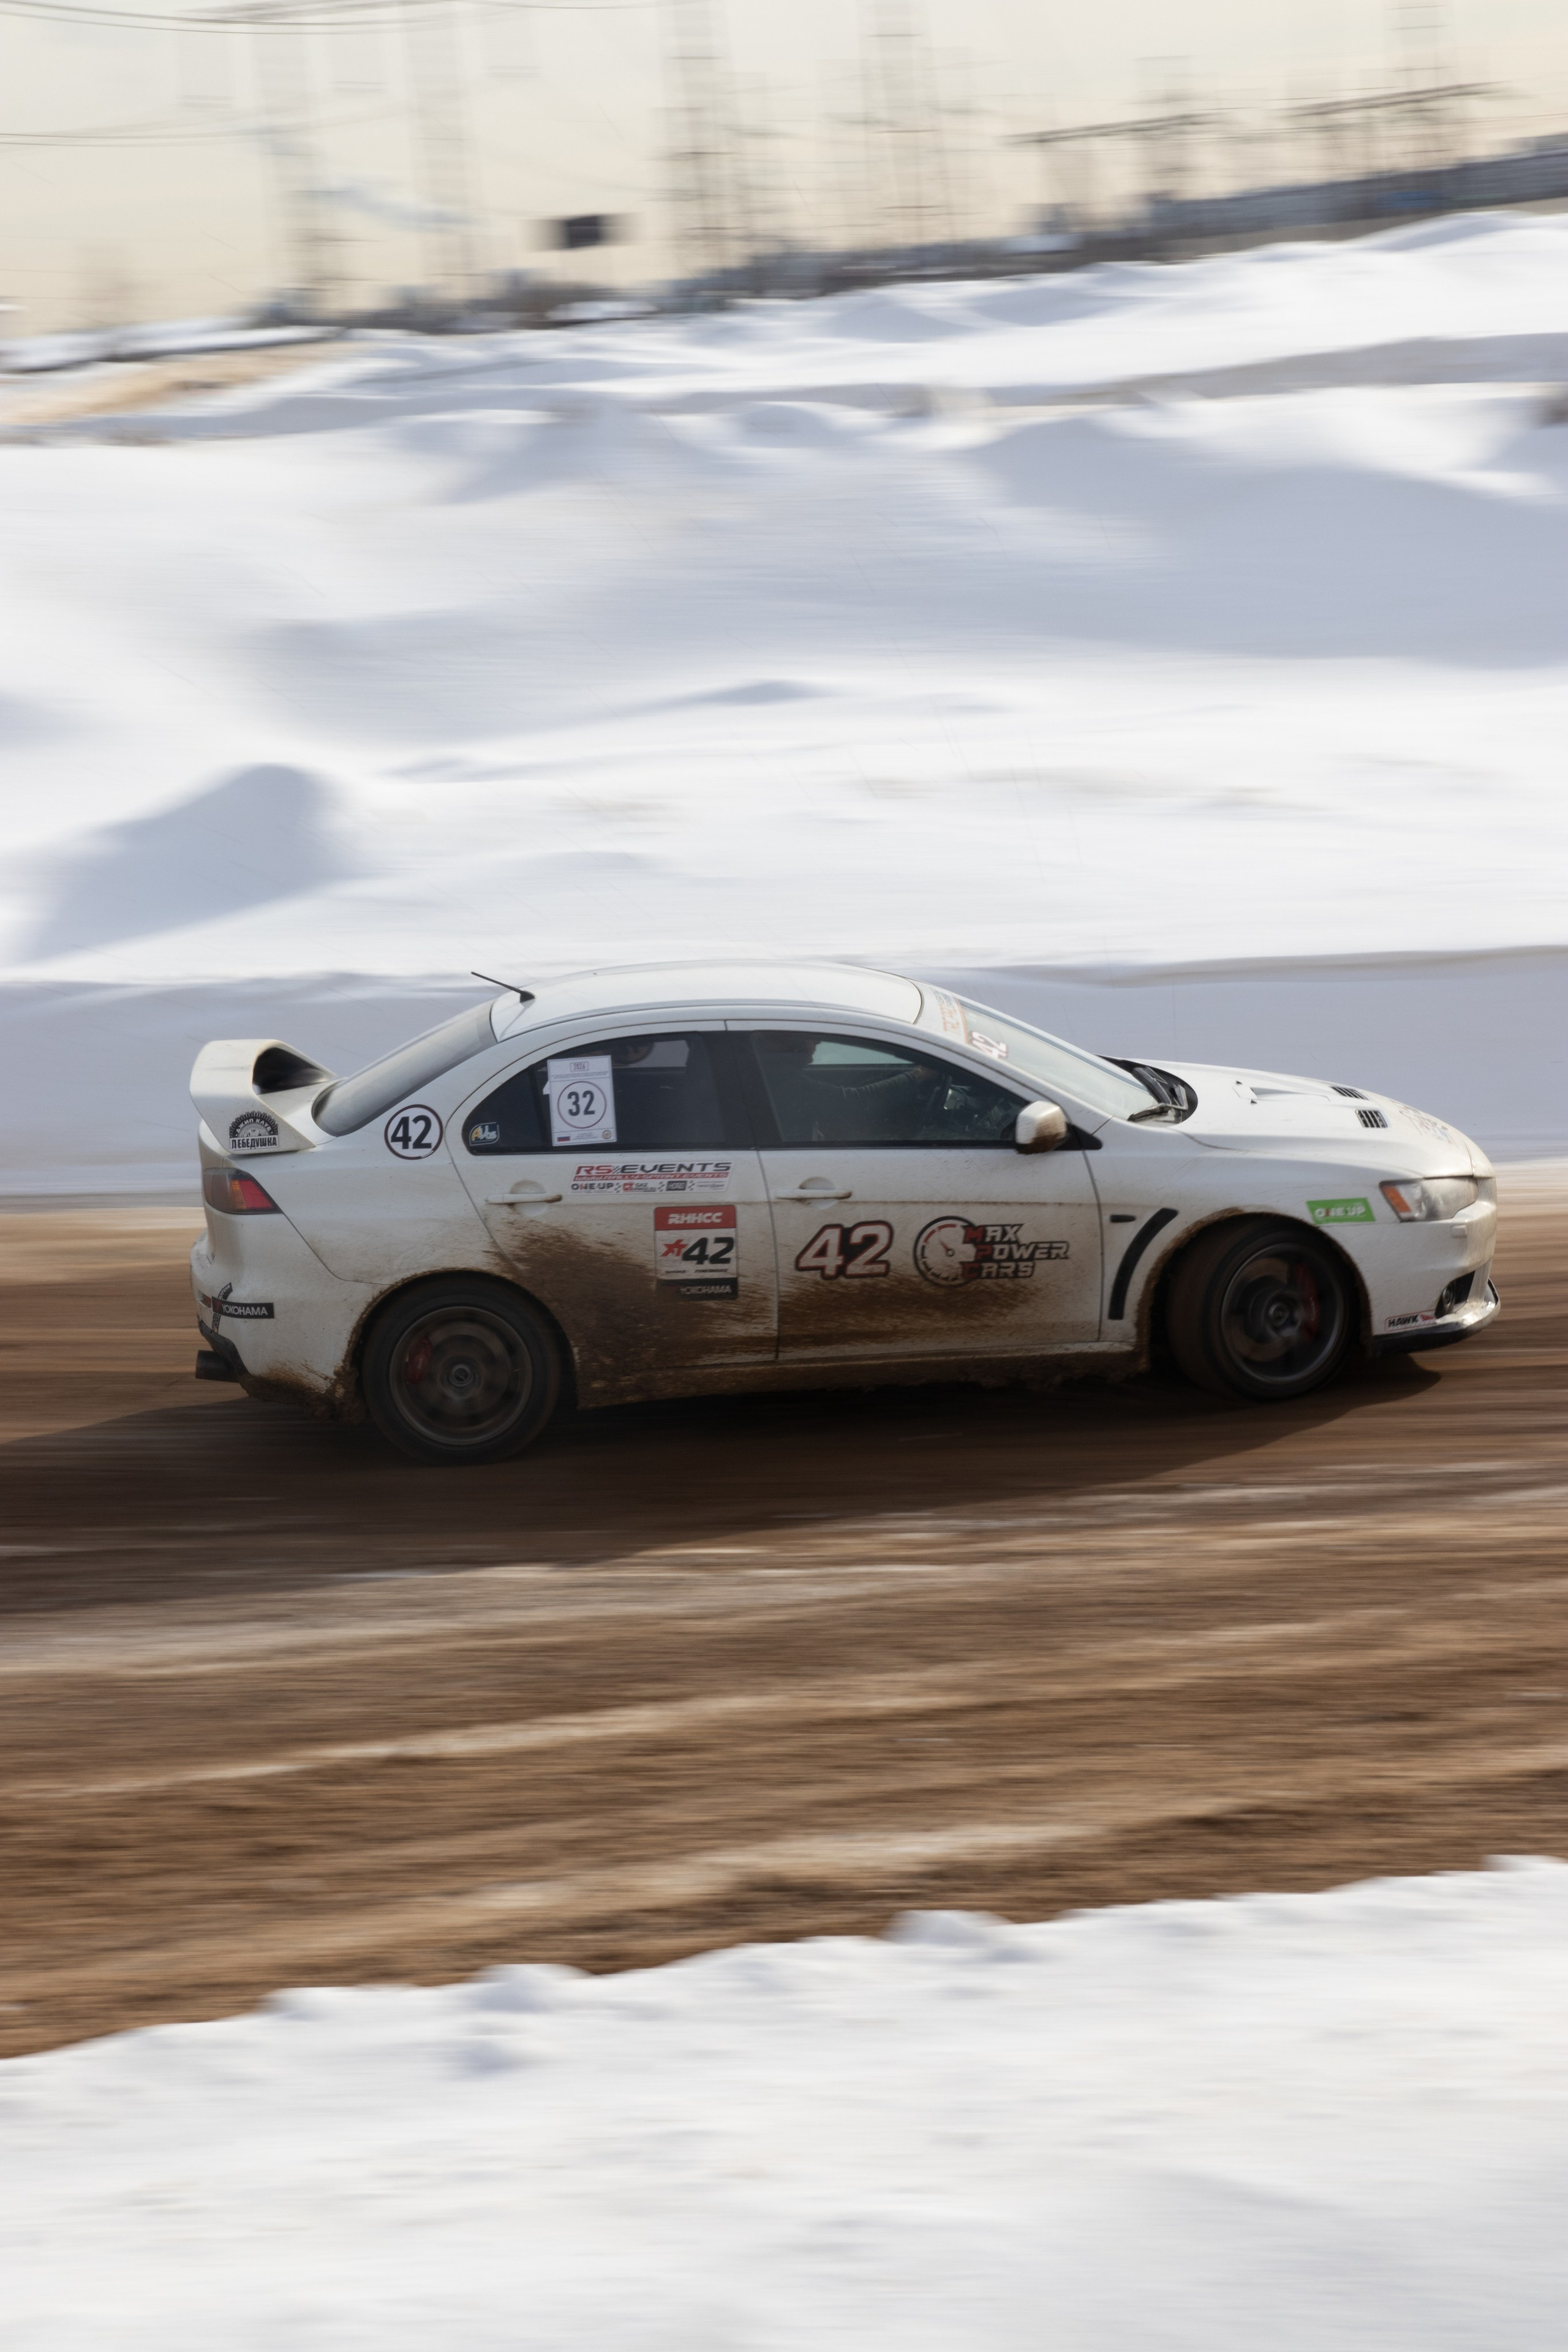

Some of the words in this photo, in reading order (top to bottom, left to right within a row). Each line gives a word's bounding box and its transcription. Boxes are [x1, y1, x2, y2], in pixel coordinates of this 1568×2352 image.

[567, 1090, 595, 1117] 32
[236, 1118, 254, 1133] ДЖИП
[256, 1118, 272, 1131] КЛУБ
[390, 1115, 432, 1150] 42
[232, 1137, 277, 1149] ЛЕБЕДУШКА
[576, 1165, 612, 1174] RS
[620, 1163, 732, 1173] EVENTS
[963, 1225, 1022, 1244] MAX
[682, 1237, 734, 1265] 42
[795, 1220, 894, 1280] 42
[976, 1243, 1069, 1259] POWER
[962, 1262, 1035, 1278] CARS
[222, 1304, 268, 1316] YOKOHAMA
